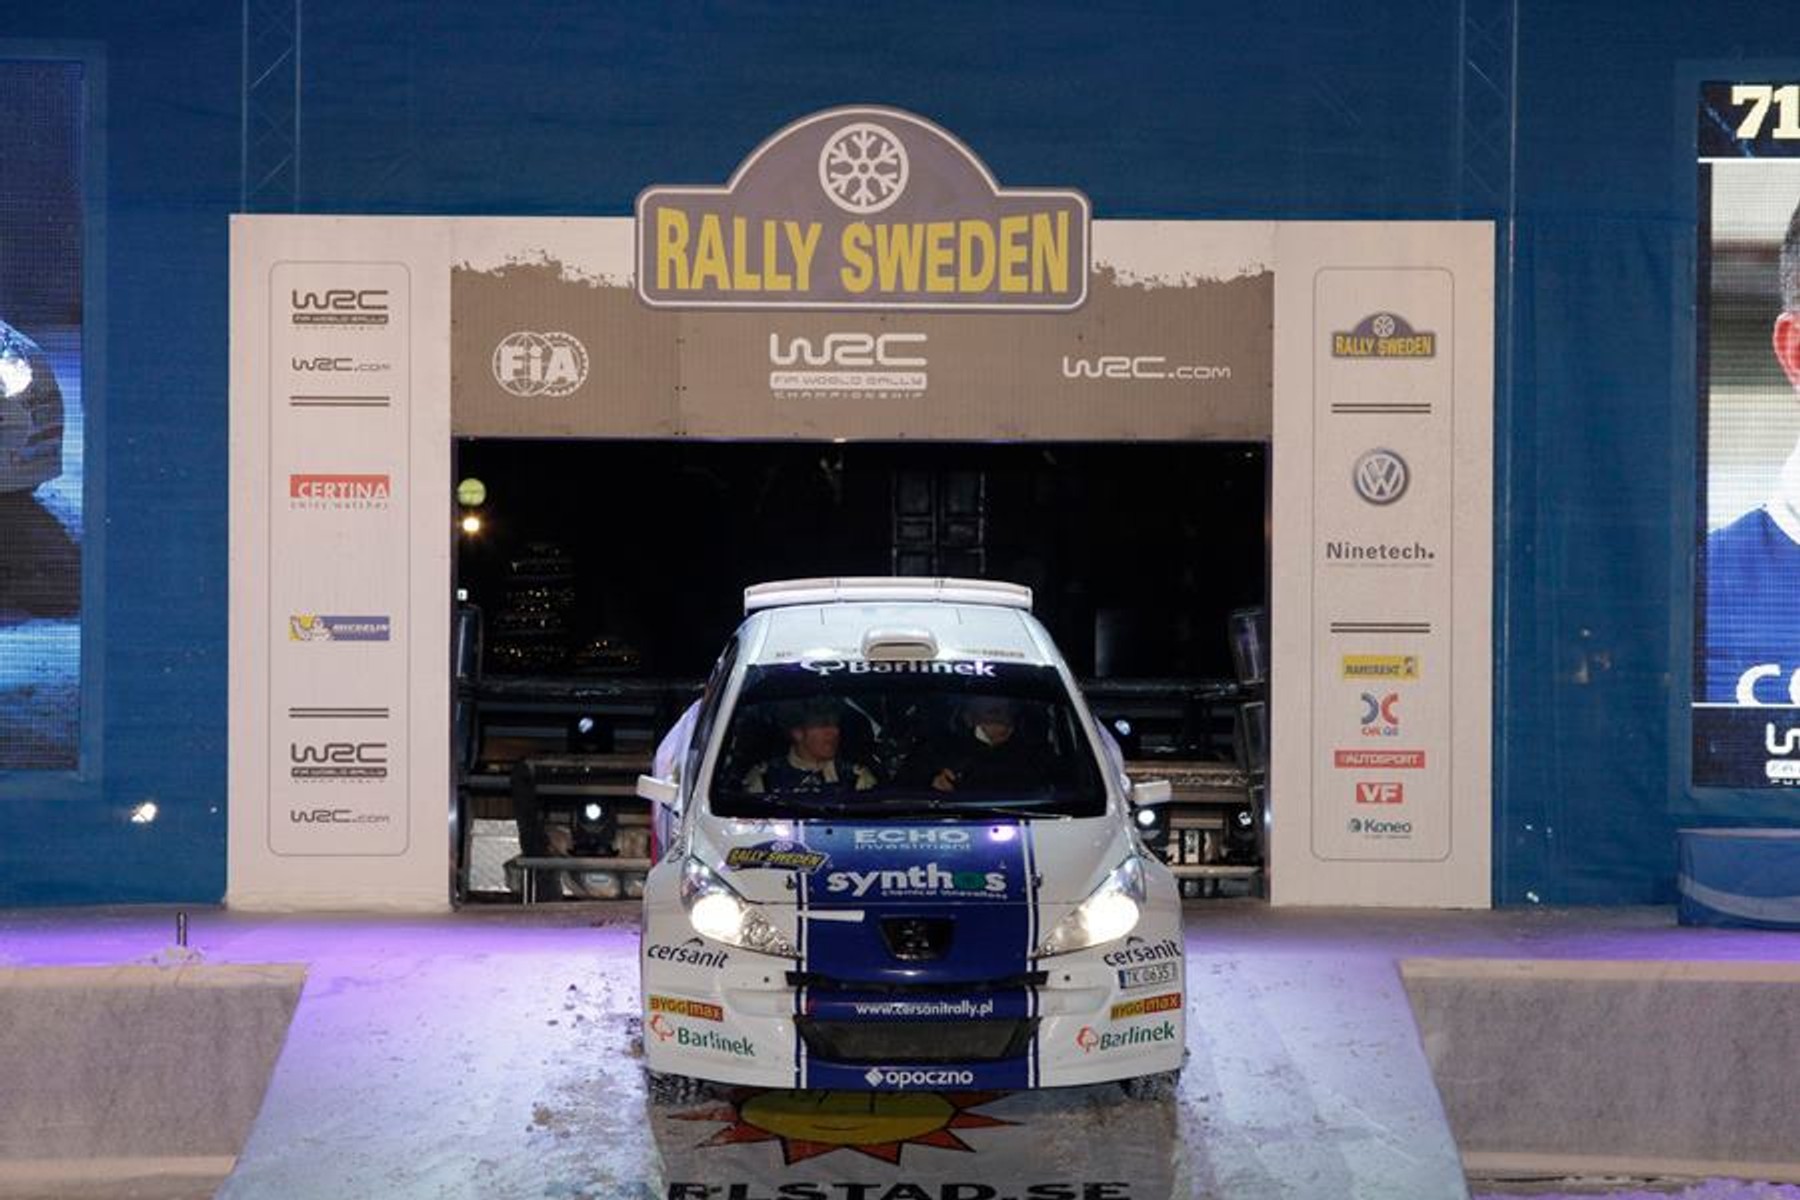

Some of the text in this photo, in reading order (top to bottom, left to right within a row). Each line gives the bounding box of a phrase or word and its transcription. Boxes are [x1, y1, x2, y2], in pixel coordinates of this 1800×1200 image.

[657, 206, 1070, 293] RALLY SWEDEN
[292, 289, 389, 310] WRC
[770, 332, 928, 366] WRC
[1335, 335, 1432, 355] RALLY SWEDEN
[802, 374, 862, 386] WORLD
[866, 374, 924, 386] RALLY
[297, 481, 389, 499] CERTINA
[850, 659, 996, 677] Barlinek
[291, 742, 387, 763] WRC
[1360, 783, 1400, 801] VF
[855, 829, 970, 843] ECHO
[1364, 819, 1412, 833] Koneo
[731, 847, 822, 868] RALLY SWEDEN
[827, 862, 1007, 897] synthos
[647, 943, 730, 969] cersanit
[1103, 939, 1182, 967] cersanit
[856, 999, 994, 1017] www.cersanitrally.pl
[677, 1027, 756, 1057] Barlinek
[1100, 1020, 1175, 1051] Barlinek
[886, 1070, 974, 1090] opoczno
